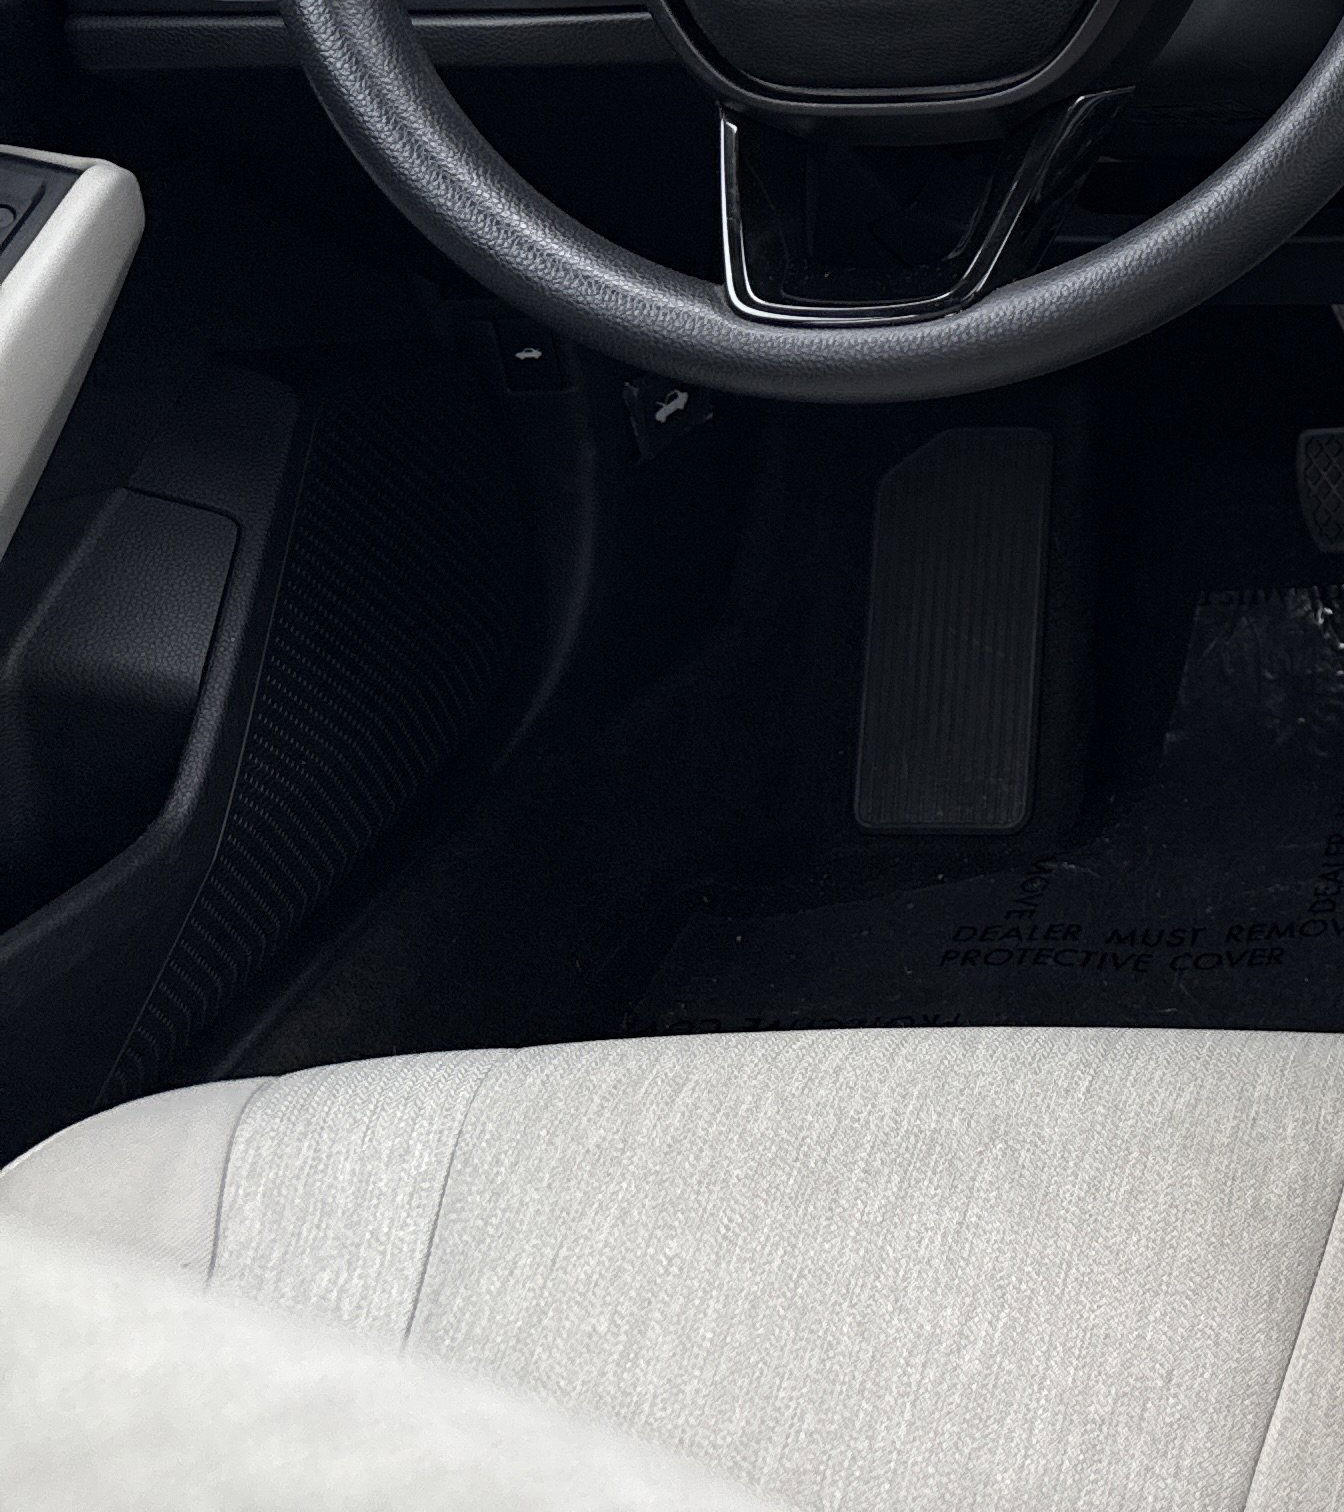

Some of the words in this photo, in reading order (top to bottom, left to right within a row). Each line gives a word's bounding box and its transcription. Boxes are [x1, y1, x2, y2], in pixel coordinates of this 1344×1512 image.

[953, 923, 1083, 945] DEALER
[1105, 926, 1215, 951] MUST
[941, 946, 1154, 974] PROTECTIVE
[1169, 947, 1285, 972] COVER
